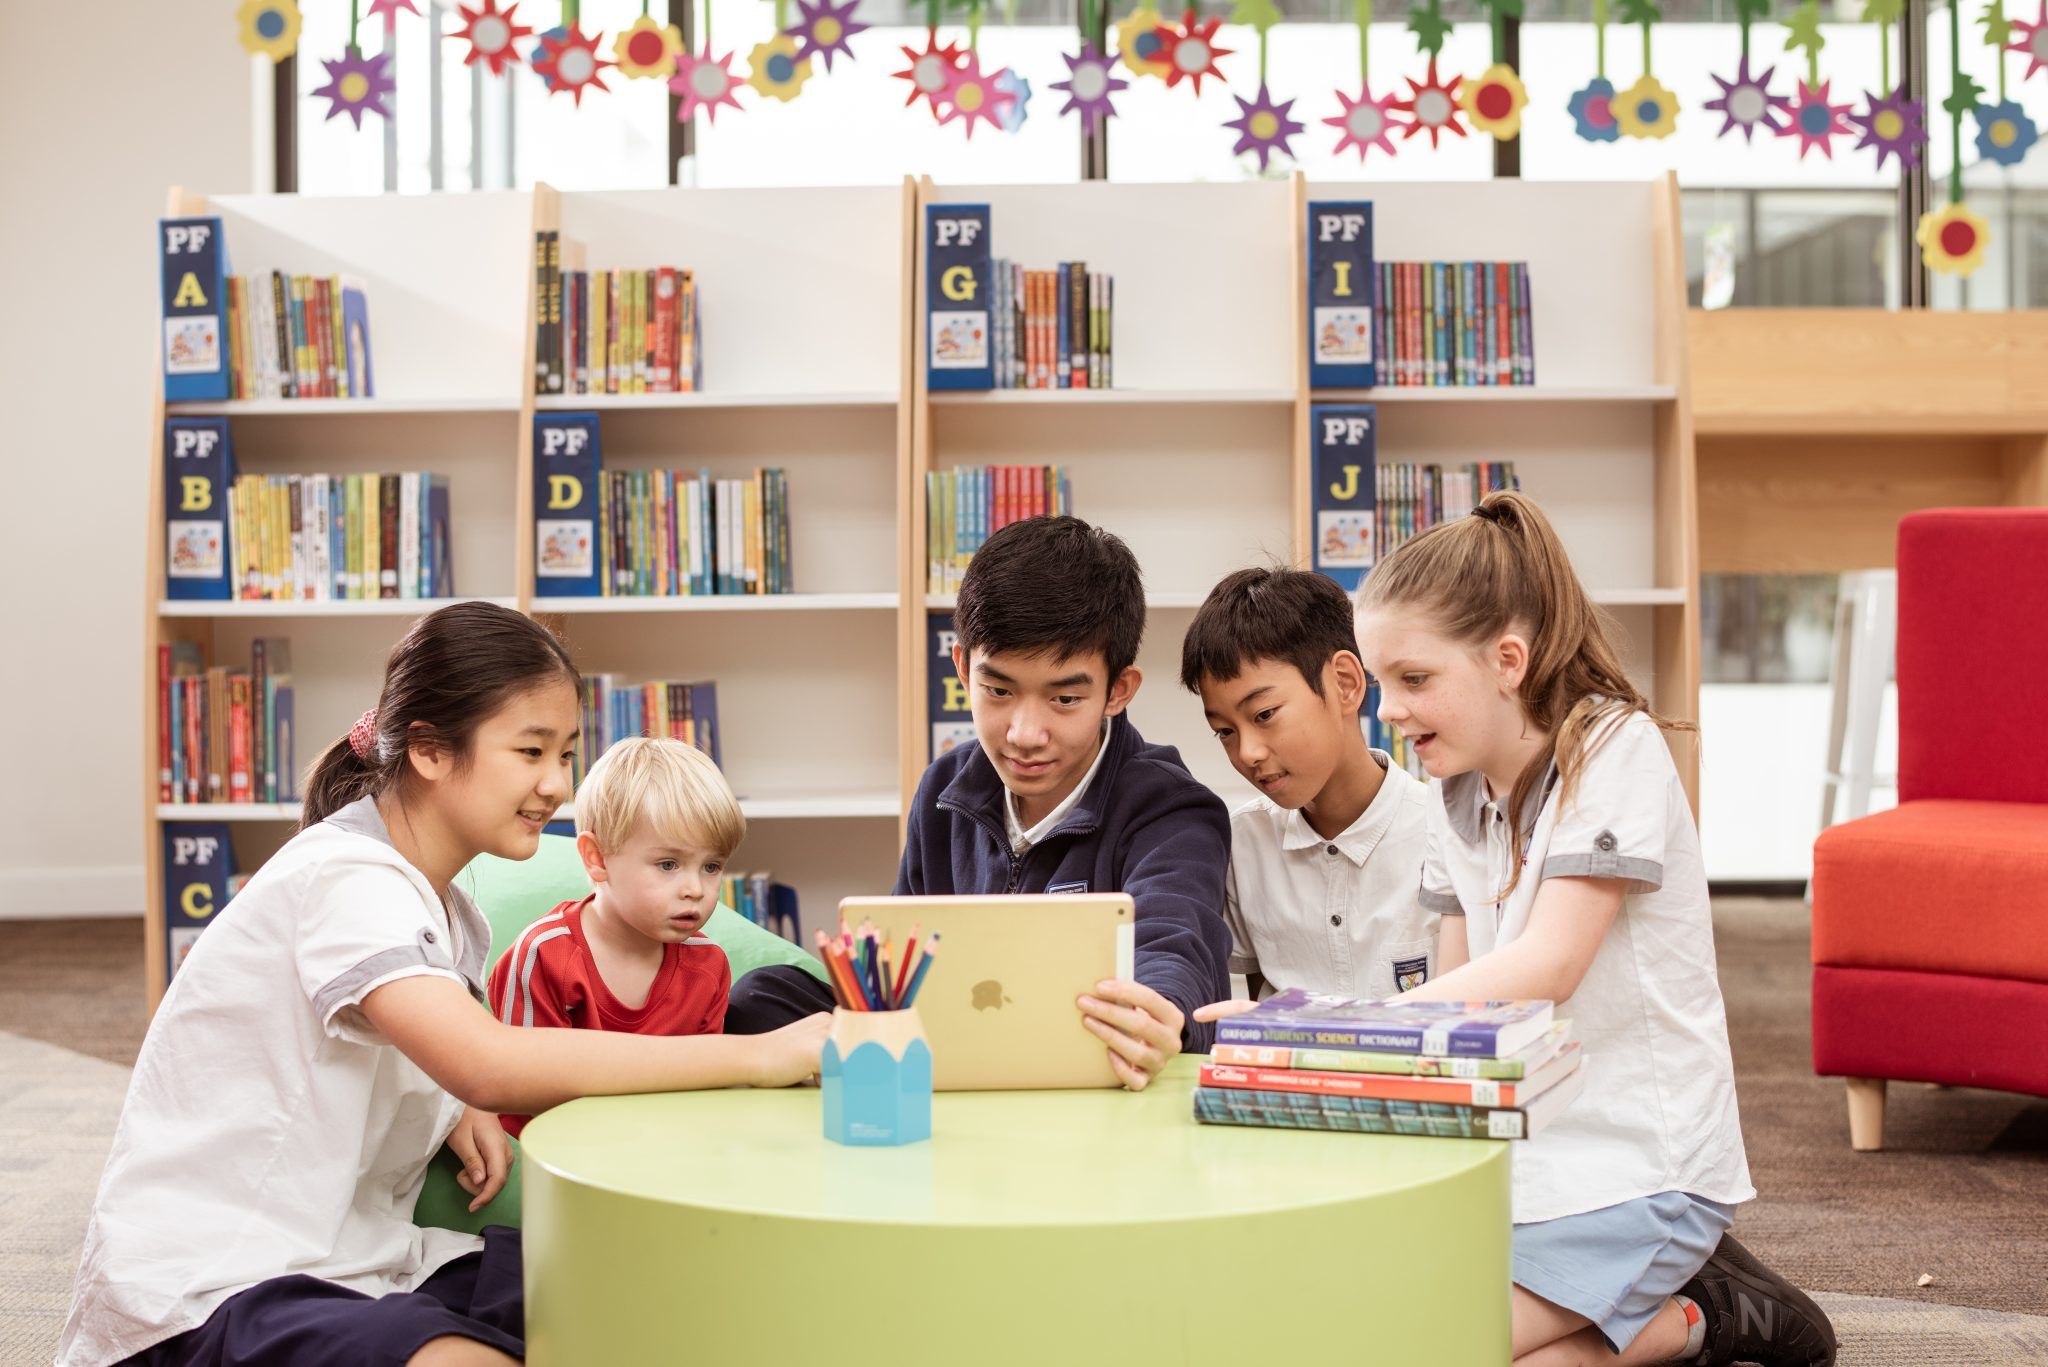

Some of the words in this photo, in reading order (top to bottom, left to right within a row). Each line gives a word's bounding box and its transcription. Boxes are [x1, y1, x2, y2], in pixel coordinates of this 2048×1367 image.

[165, 225, 210, 254] PF
[934, 219, 982, 246] PF
[1318, 214, 1364, 242] PF
[173, 272, 208, 308] A
[941, 266, 978, 301] G
[1333, 261, 1351, 296] I
[174, 430, 219, 458] PF
[543, 428, 588, 456] PF
[1323, 418, 1369, 446] PF
[181, 476, 212, 511] B
[548, 475, 583, 510] D
[1330, 465, 1361, 500] J
[942, 677, 971, 711] H
[174, 836, 218, 865] PF
[181, 882, 214, 918] C
[1220, 1028, 1261, 1041] OXFORD
[1263, 1031, 1314, 1043] STUDENT'S
[1316, 1032, 1357, 1045] SCIENCE
[1359, 1034, 1419, 1048] DICTIONARY
[1211, 1068, 1248, 1082] Collins
[1738, 1292, 1773, 1341] N
